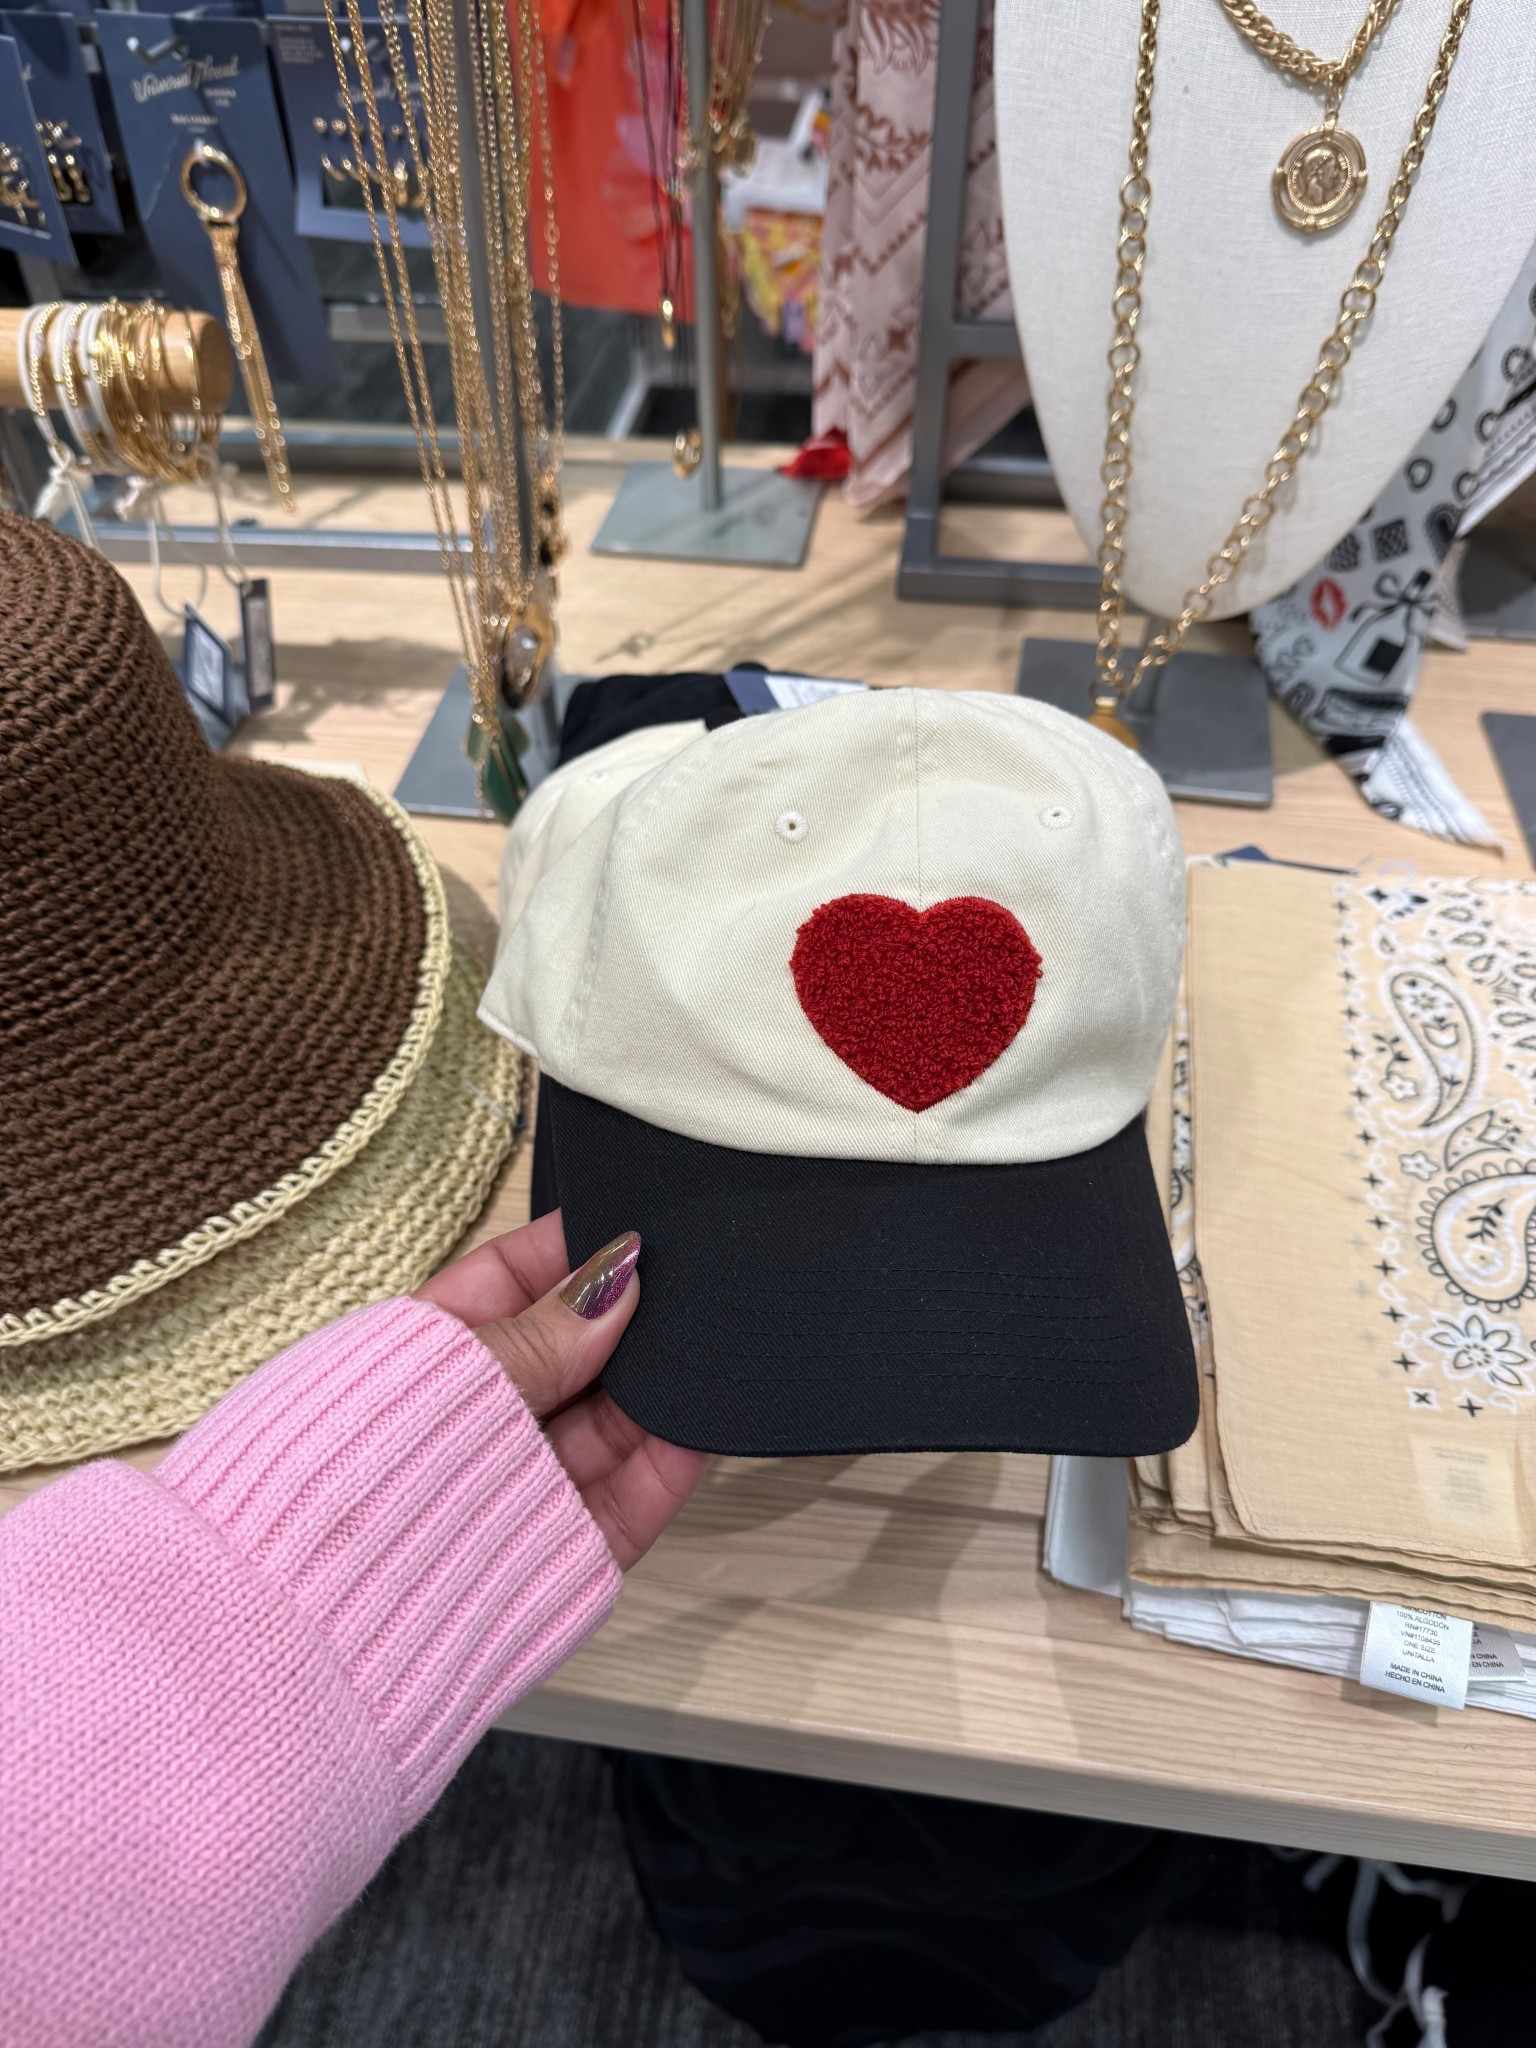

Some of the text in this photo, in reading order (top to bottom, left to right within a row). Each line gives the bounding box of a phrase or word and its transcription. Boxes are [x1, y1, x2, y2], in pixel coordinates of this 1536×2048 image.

[1396, 1610, 1414, 1621] 100%
[1403, 1640, 1436, 1654] ONE SIZE
[1402, 1648, 1435, 1663] UNITALLA
[1390, 1662, 1443, 1683] MADE IN CHINA
[1384, 1670, 1446, 1693] HECHO EN CHINA
